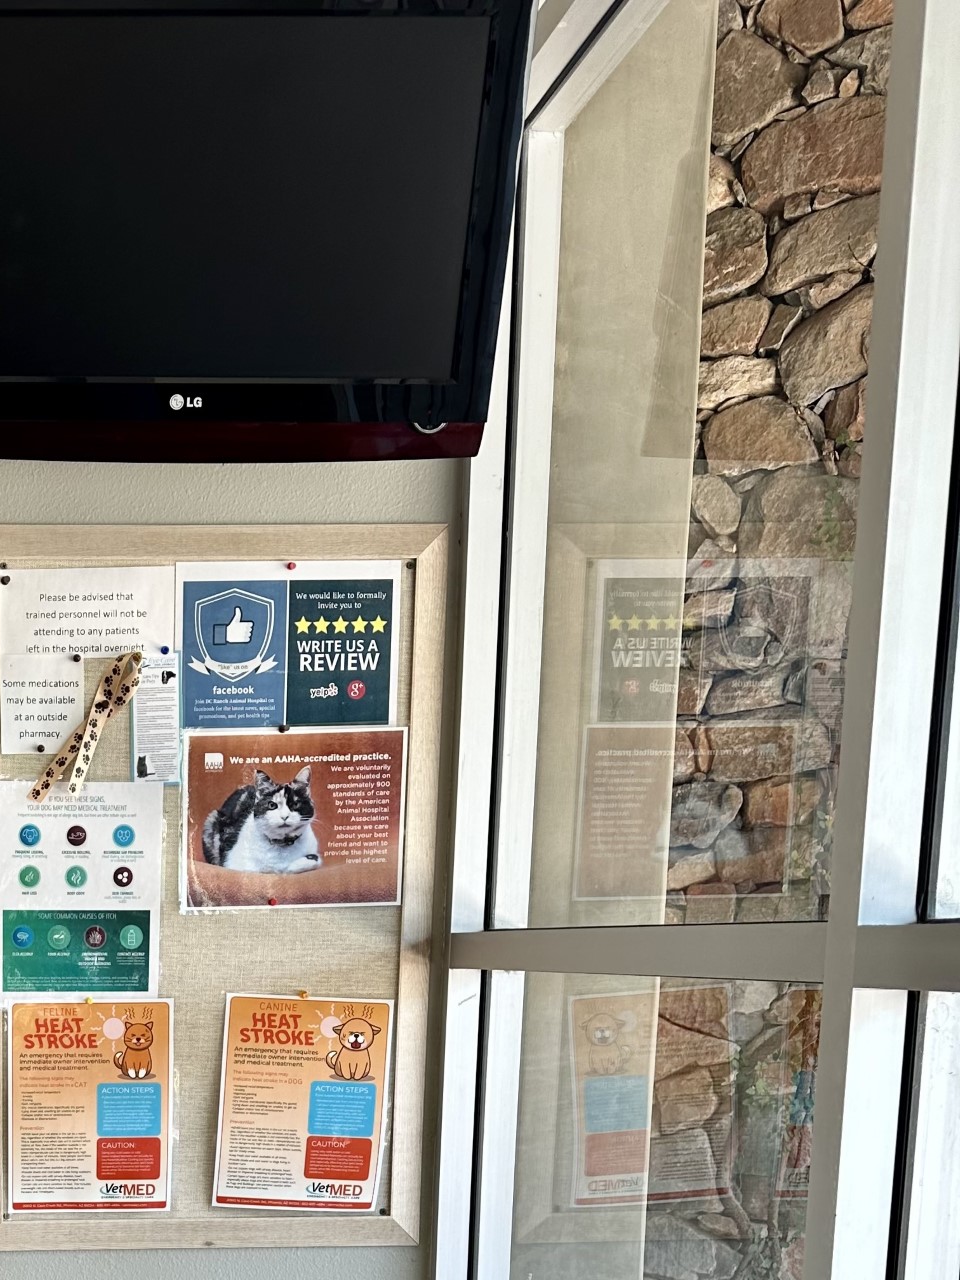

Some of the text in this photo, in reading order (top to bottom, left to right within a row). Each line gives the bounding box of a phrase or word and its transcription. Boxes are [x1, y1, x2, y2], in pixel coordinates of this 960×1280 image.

[187, 397, 202, 408] LG
[40, 593, 133, 602] Please be advised that
[26, 611, 56, 619] trained
[59, 610, 100, 621] personnel
[103, 610, 117, 618] will
[120, 610, 134, 618] not
[34, 627, 139, 637] attending to any patients
[27, 645, 39, 653] left
[69, 644, 101, 653] hospital
[297, 640, 378, 653] WRITE US A
[300, 653, 380, 671] REVIEW
[29, 679, 79, 687] medications
[213, 685, 254, 694] facebook
[311, 686, 328, 697] yelp
[7, 696, 75, 705] may be available
[38, 713, 67, 721] outside
[20, 730, 62, 739] pharmacy.
[275, 754, 350, 763] AAHA-accredited
[353, 753, 391, 762] practice.
[327, 782, 374, 790] approximately
[260, 1002, 297, 1011] CANINE
[43, 1008, 77, 1016] FELINE
[35, 1018, 83, 1033] HEAT
[252, 1013, 302, 1029] HEAT
[25, 1034, 98, 1049] STROKE
[240, 1028, 314, 1046] STROKE
[106, 1183, 155, 1196] VetMED
[312, 1182, 362, 1196] VetMED
